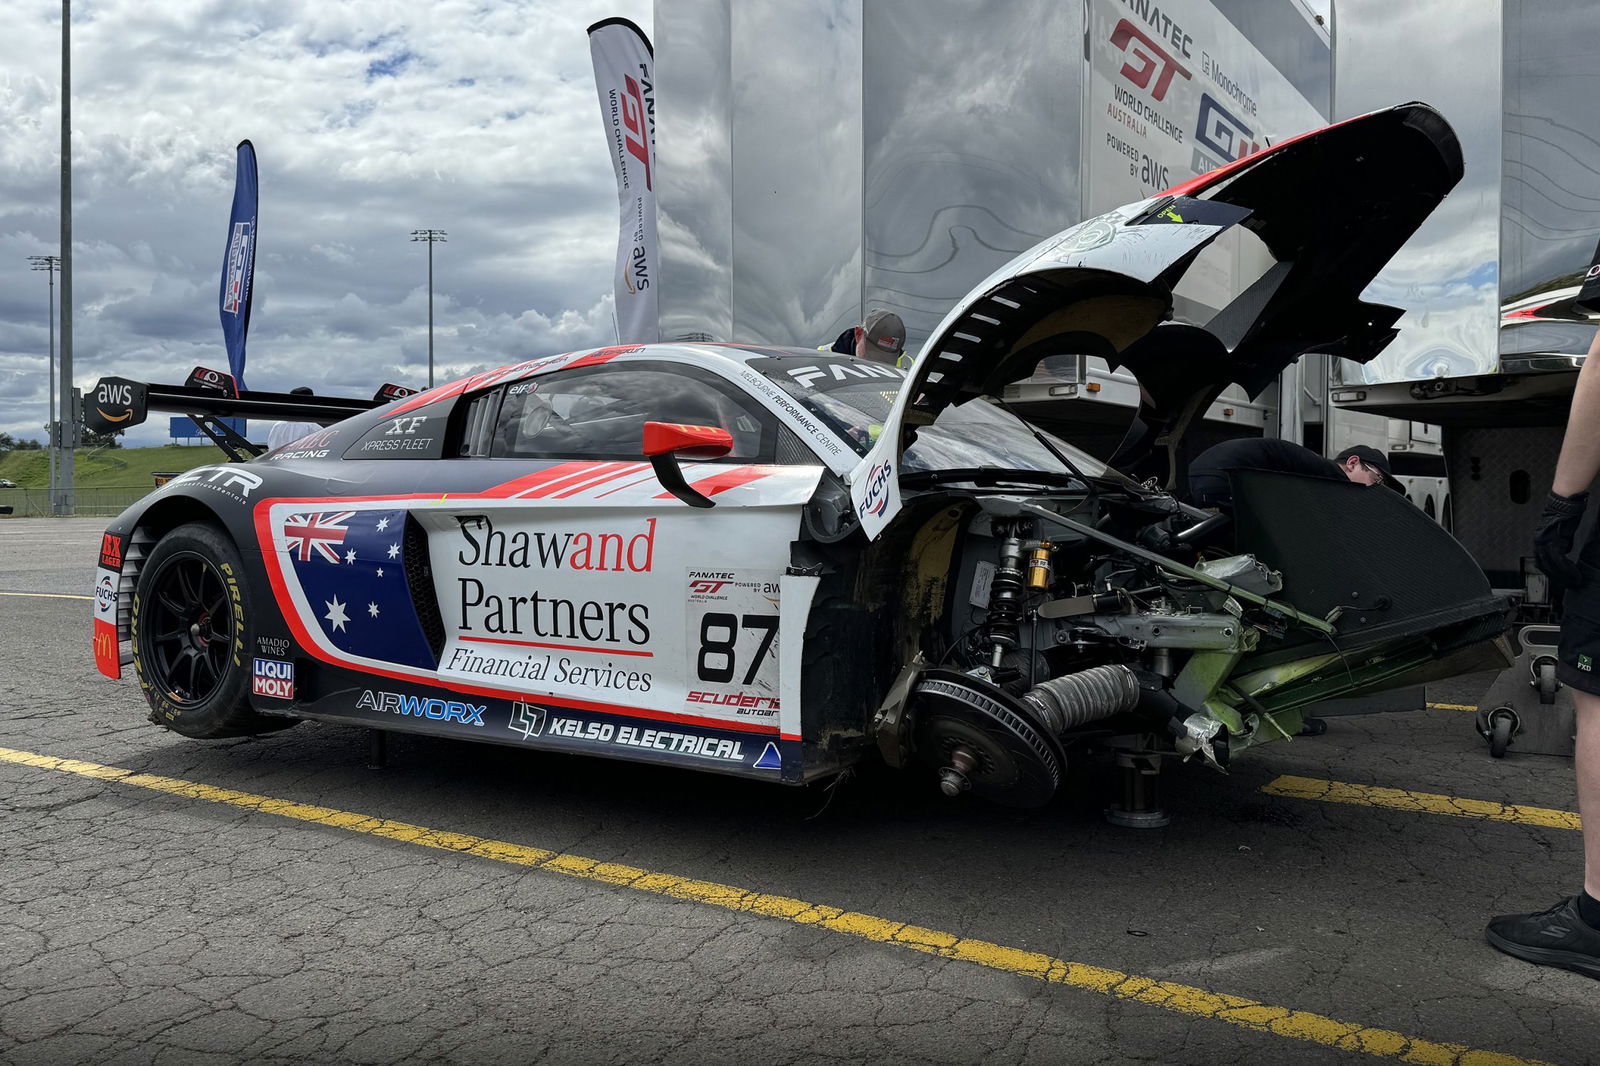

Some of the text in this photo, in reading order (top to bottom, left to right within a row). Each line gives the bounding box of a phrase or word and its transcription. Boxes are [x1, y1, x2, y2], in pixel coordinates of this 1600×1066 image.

[1212, 60, 1257, 116] Monochrome
[1107, 103, 1147, 138] AUSTRALIA
[1114, 84, 1183, 144] WORLD CHALLENGE
[609, 88, 629, 190] WORLD CHALLENGE
[1106, 132, 1139, 162] POWERED
[1129, 154, 1169, 191] BY aws
[1157, 205, 1176, 219] OPEN
[633, 246, 649, 291] aws
[98, 383, 132, 406] aws
[509, 384, 529, 395] elf
[386, 416, 427, 436] XF
[740, 371, 842, 456] MELBOURNE PERFORMANCE CENTRE
[270, 450, 330, 460] RACING
[361, 438, 433, 451] XPRESS FLEET
[859, 459, 892, 519] FUCHS
[96, 586, 119, 602] FUCHS
[458, 578, 650, 645] Partners
[220, 562, 245, 667] PIRELLI
[256, 636, 290, 649] AMADIO
[261, 645, 285, 656] WINES
[697, 612, 780, 685] 87
[255, 660, 292, 680] LIQUI
[255, 677, 293, 697] MOLY
[446, 648, 653, 692] Financial Services
[356, 689, 487, 726] AIRWORX
[549, 717, 745, 760] KELSO ELECTRICAL
